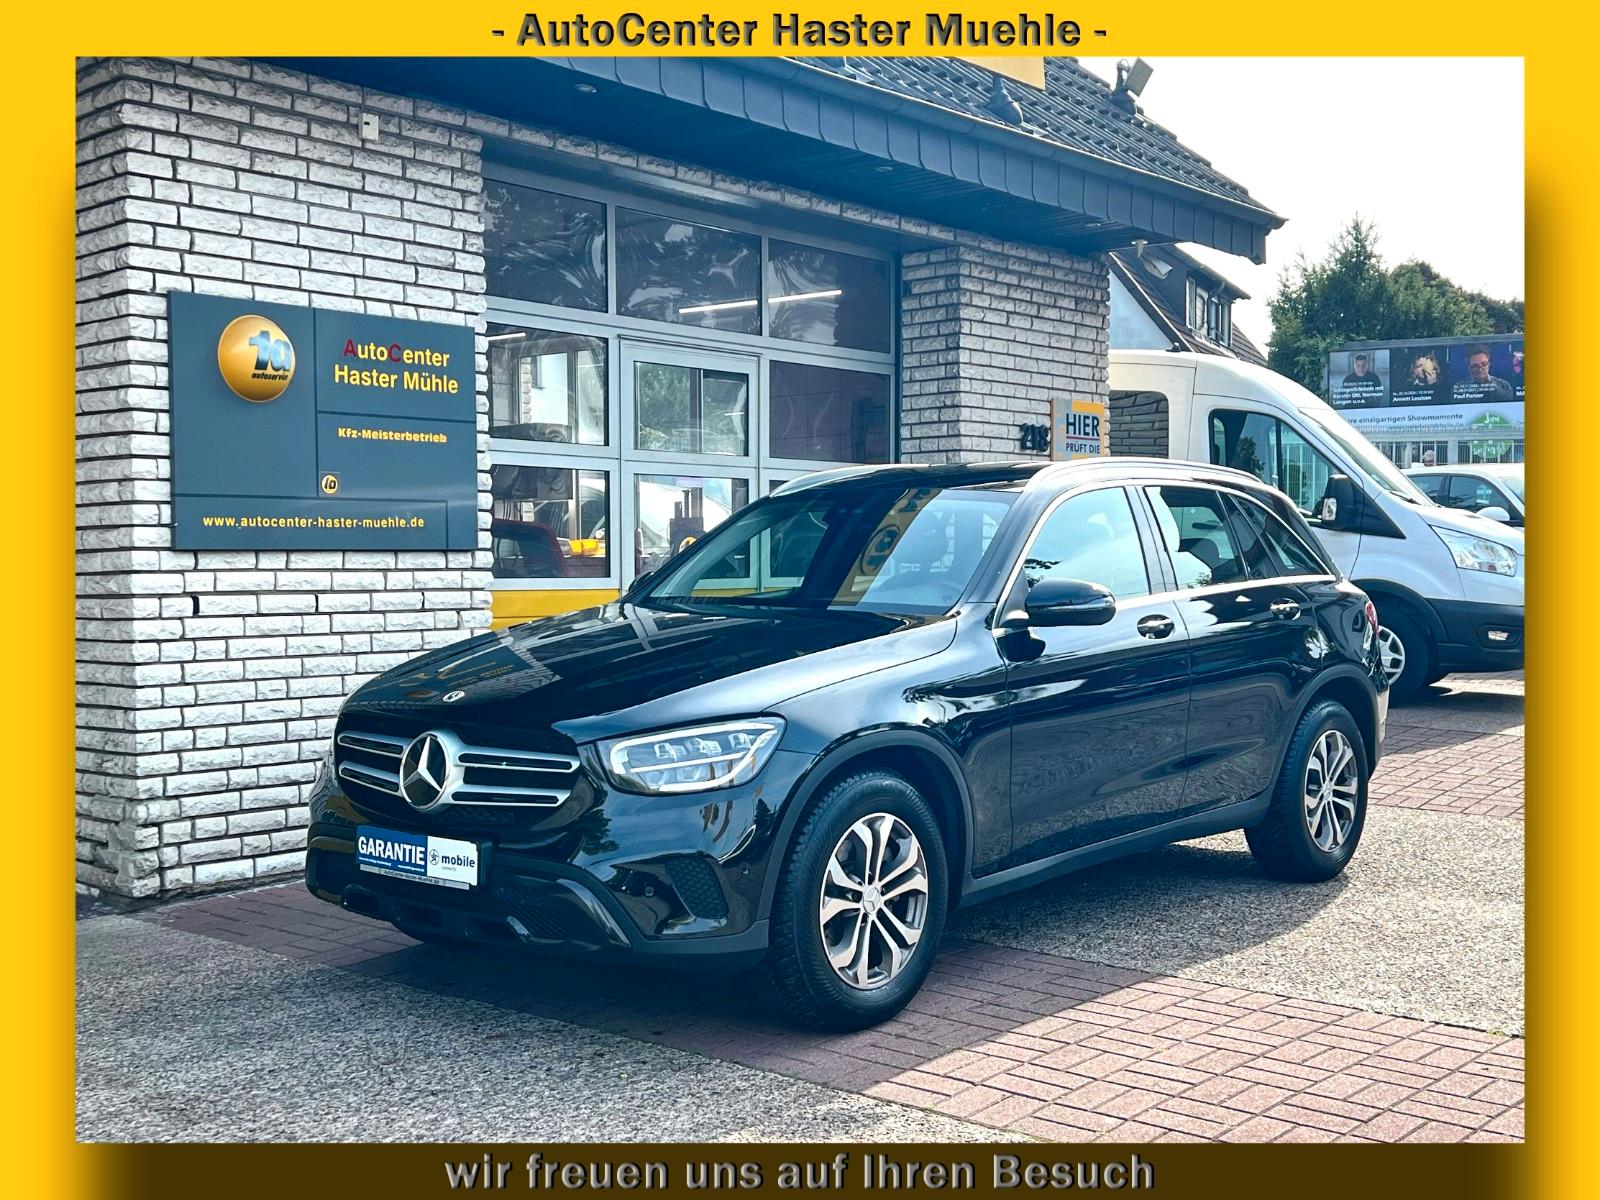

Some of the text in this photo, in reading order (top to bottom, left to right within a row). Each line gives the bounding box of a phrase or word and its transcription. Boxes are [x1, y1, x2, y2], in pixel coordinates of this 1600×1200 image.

[343, 339, 450, 368] AutoCenter
[334, 364, 459, 394] Haster Mühle
[338, 427, 447, 443] Kfz-Meisterbetrieb
[1065, 413, 1100, 437] HIER
[1065, 441, 1100, 454] PRÜFT DIE
[203, 515, 425, 529] www.autocenter-haster-muehle.de
[358, 836, 426, 866] GARANTIE
[441, 854, 476, 868] mobile
